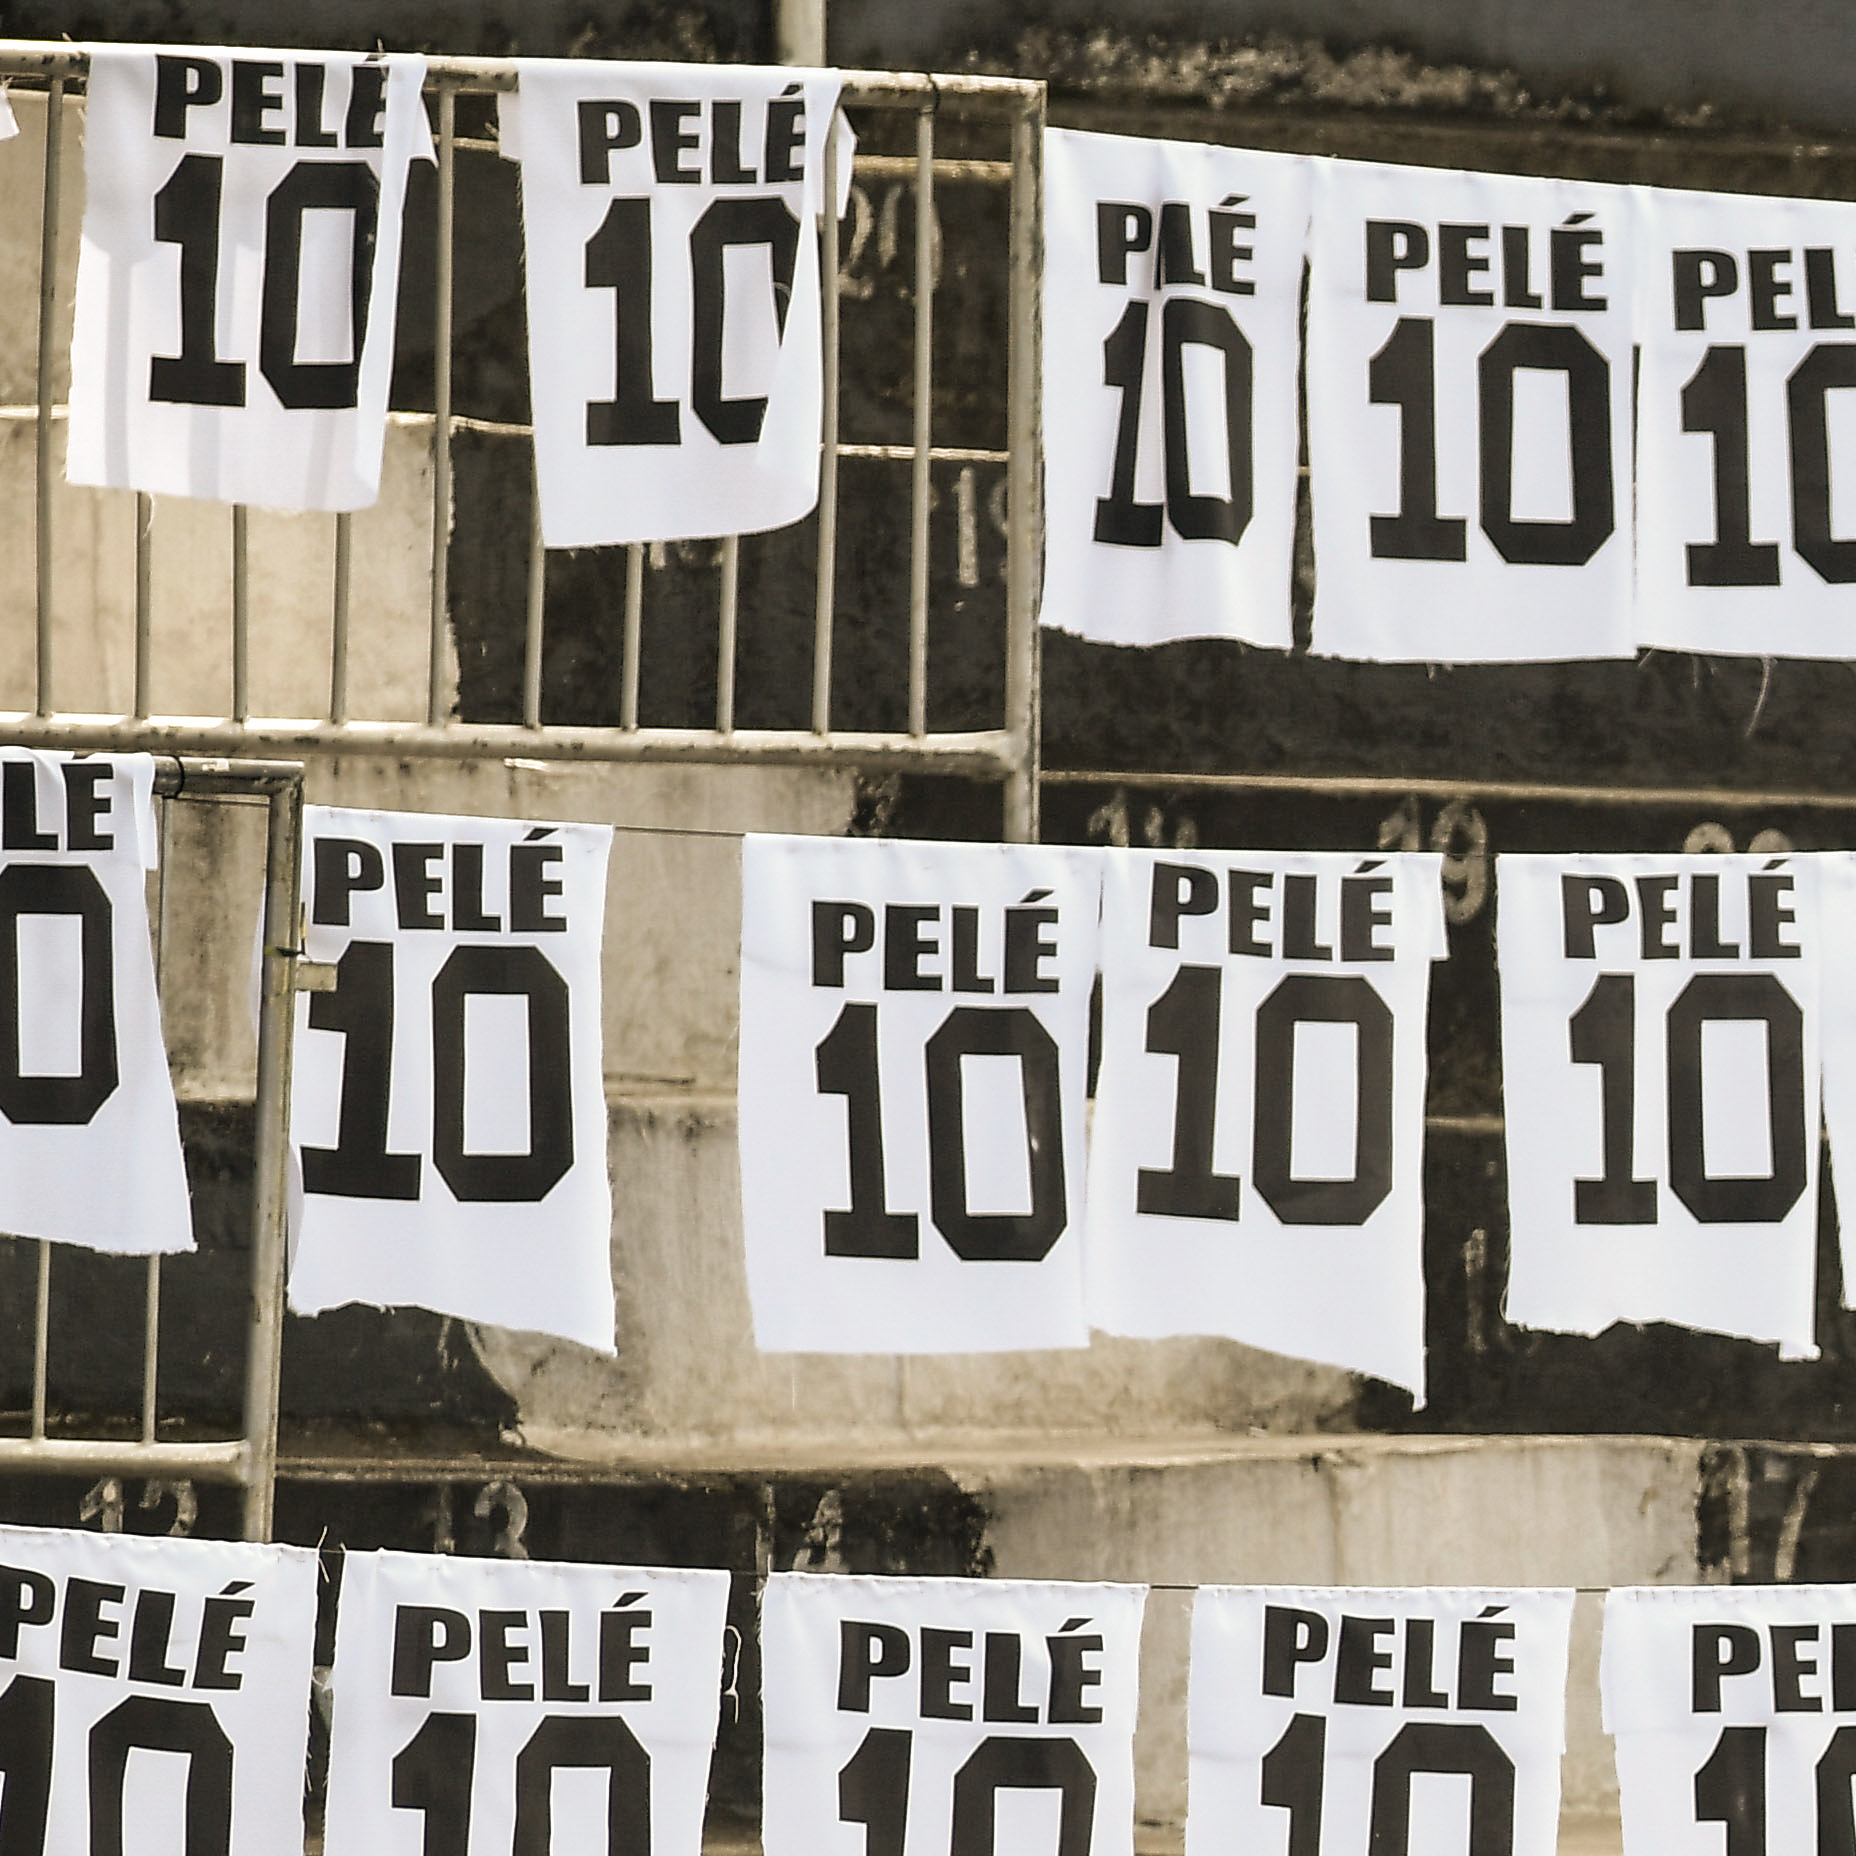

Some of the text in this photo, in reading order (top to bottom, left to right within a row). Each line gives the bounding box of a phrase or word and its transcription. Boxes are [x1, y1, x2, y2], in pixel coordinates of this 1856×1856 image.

[576, 83, 807, 186] PELÉ
[148, 152, 382, 411] 10
[583, 195, 802, 448] 10
[1365, 212, 1609, 313] PELÉ
[1092, 296, 1254, 549] 10
[1368, 316, 1616, 568] 10
[311, 825, 570, 934] PELÉ
[1148, 859, 1396, 963] PELÉ
[1560, 856, 1802, 961] PELÉ
[811, 888, 1061, 996] PELÉ
[301, 939, 576, 1204] 10
[1135, 964, 1395, 1228] 10
[1568, 972, 1809, 1227] 10
[814, 1001, 1069, 1264] 10
[0, 1563, 256, 1692] PELÉ
[389, 1591, 653, 1704] PELÉ
[836, 1617, 1105, 1725] PELÉ
[1261, 1603, 1519, 1713] PELÉ
